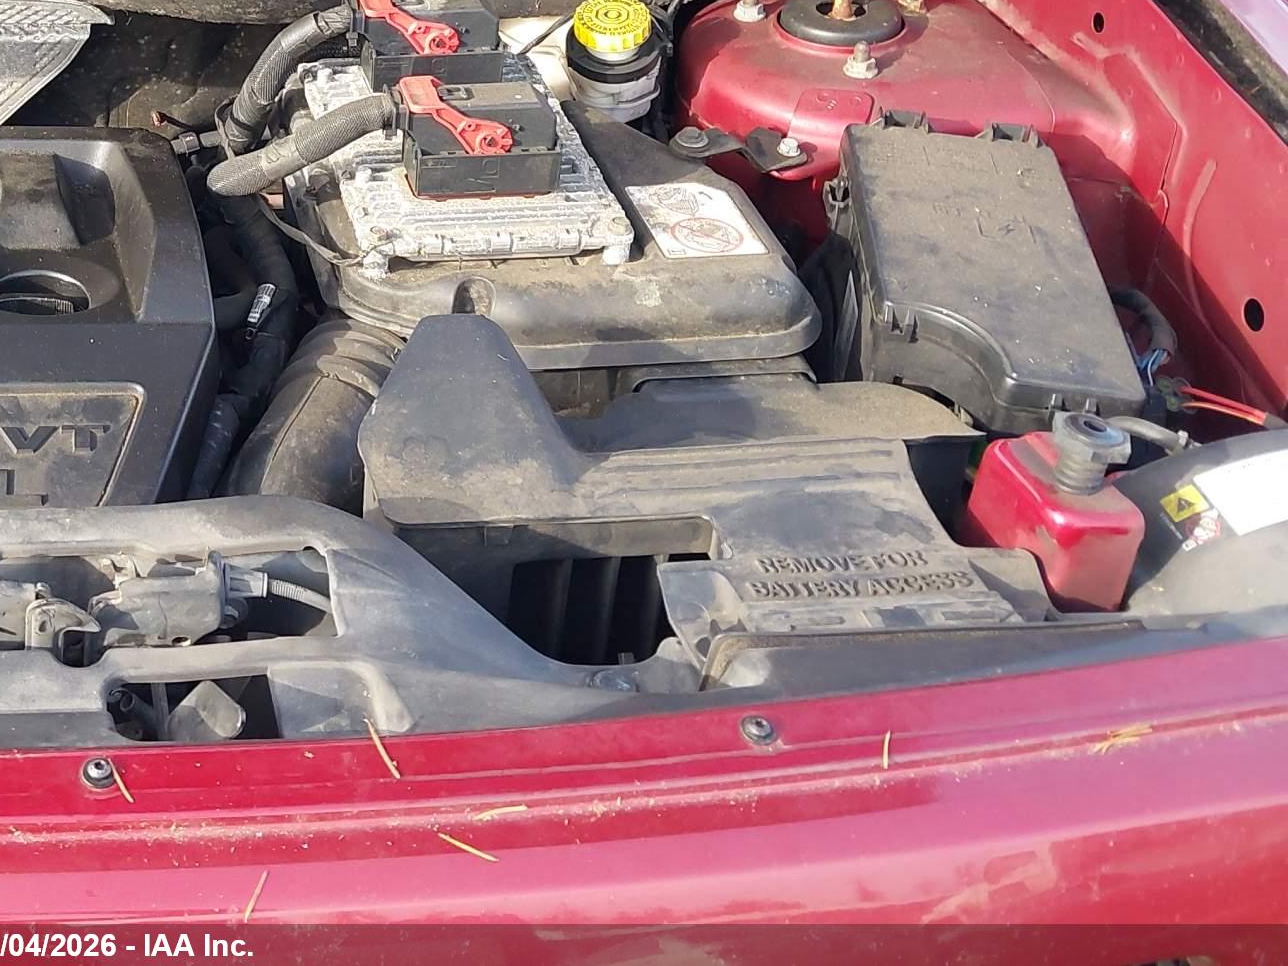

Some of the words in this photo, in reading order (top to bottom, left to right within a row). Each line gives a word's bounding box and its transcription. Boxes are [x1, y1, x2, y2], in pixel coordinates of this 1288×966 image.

[754, 554, 865, 574] REMOVE
[867, 550, 929, 571] FOR
[748, 578, 862, 598] BATTERY
[867, 571, 974, 596] ACCESS
